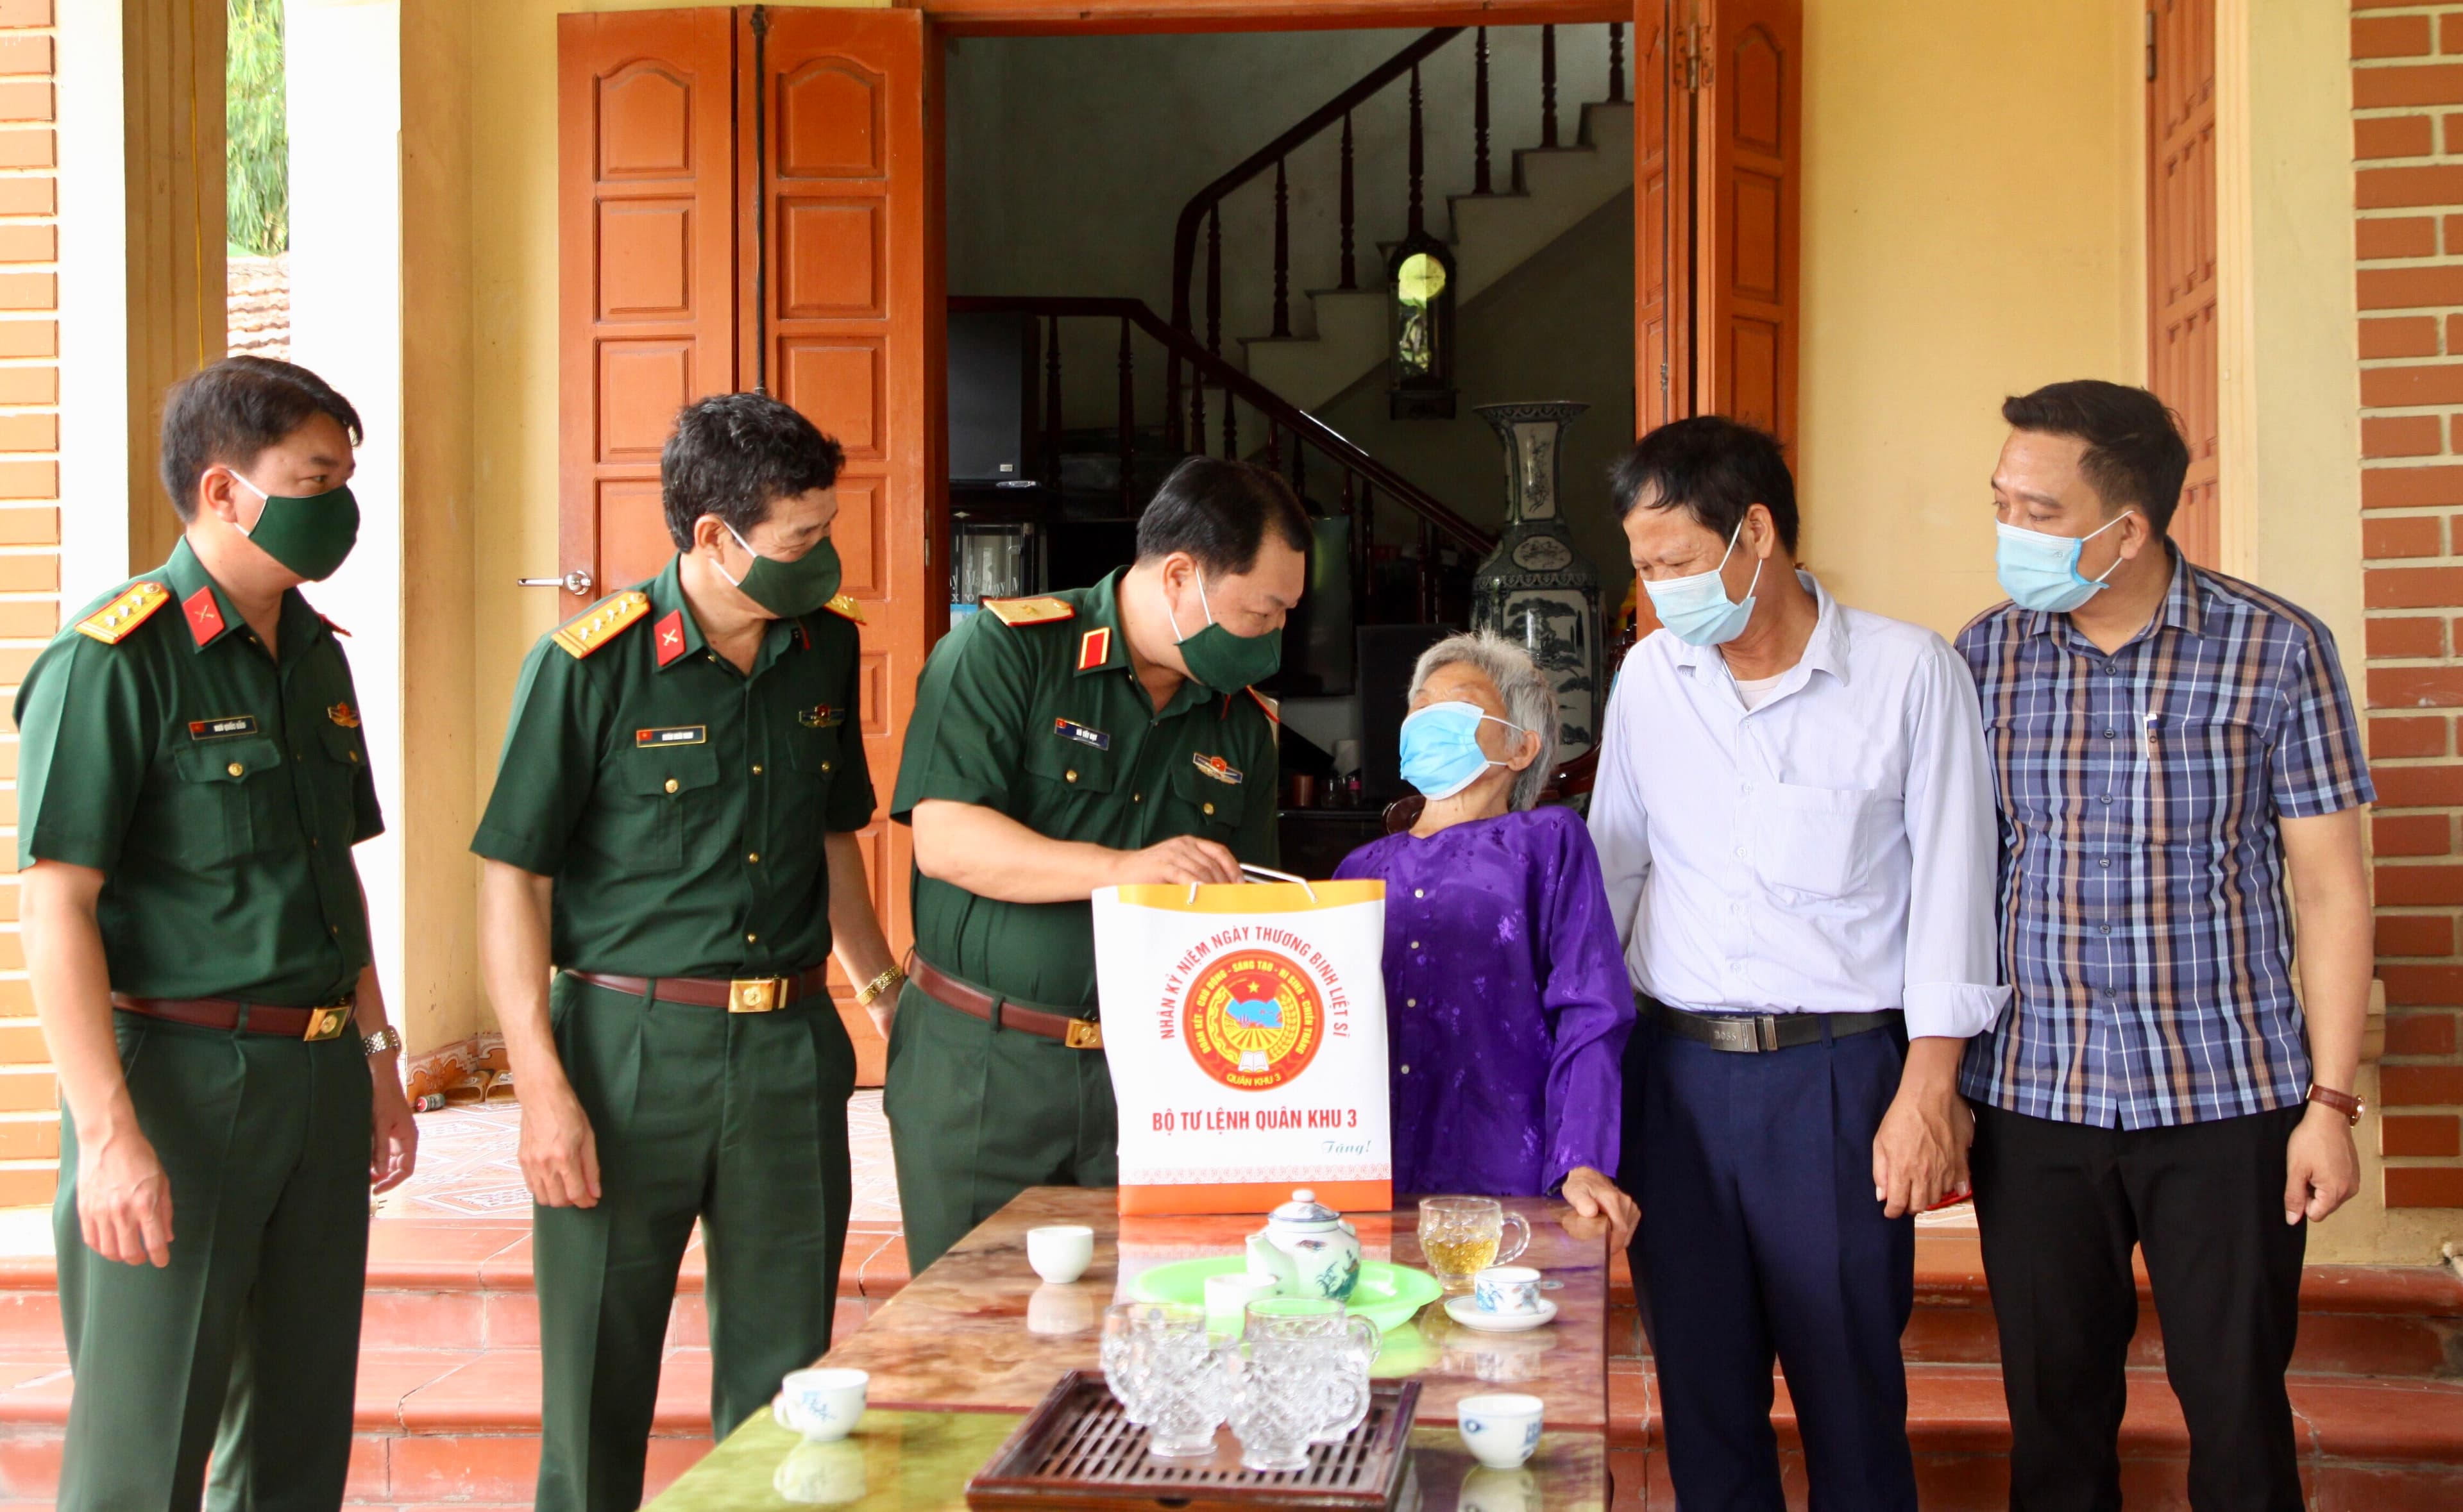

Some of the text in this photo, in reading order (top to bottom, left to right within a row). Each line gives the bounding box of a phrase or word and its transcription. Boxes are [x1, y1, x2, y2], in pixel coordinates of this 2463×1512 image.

[1156, 998, 1176, 1039] NHÂN
[1176, 942, 1211, 975] NIỆM
[1211, 925, 1249, 948] NGÀY
[1255, 927, 1311, 957] THƯƠNG
[1309, 952, 1339, 986] BINH
[1329, 987, 1350, 1017] LIỆT
[1287, 975, 1305, 995] SINH
[1226, 1072, 1282, 1087] QUÂN KHU 3
[1153, 1106, 1357, 1136] BỘ TƯ LỆNH QUÂN KHU 3
